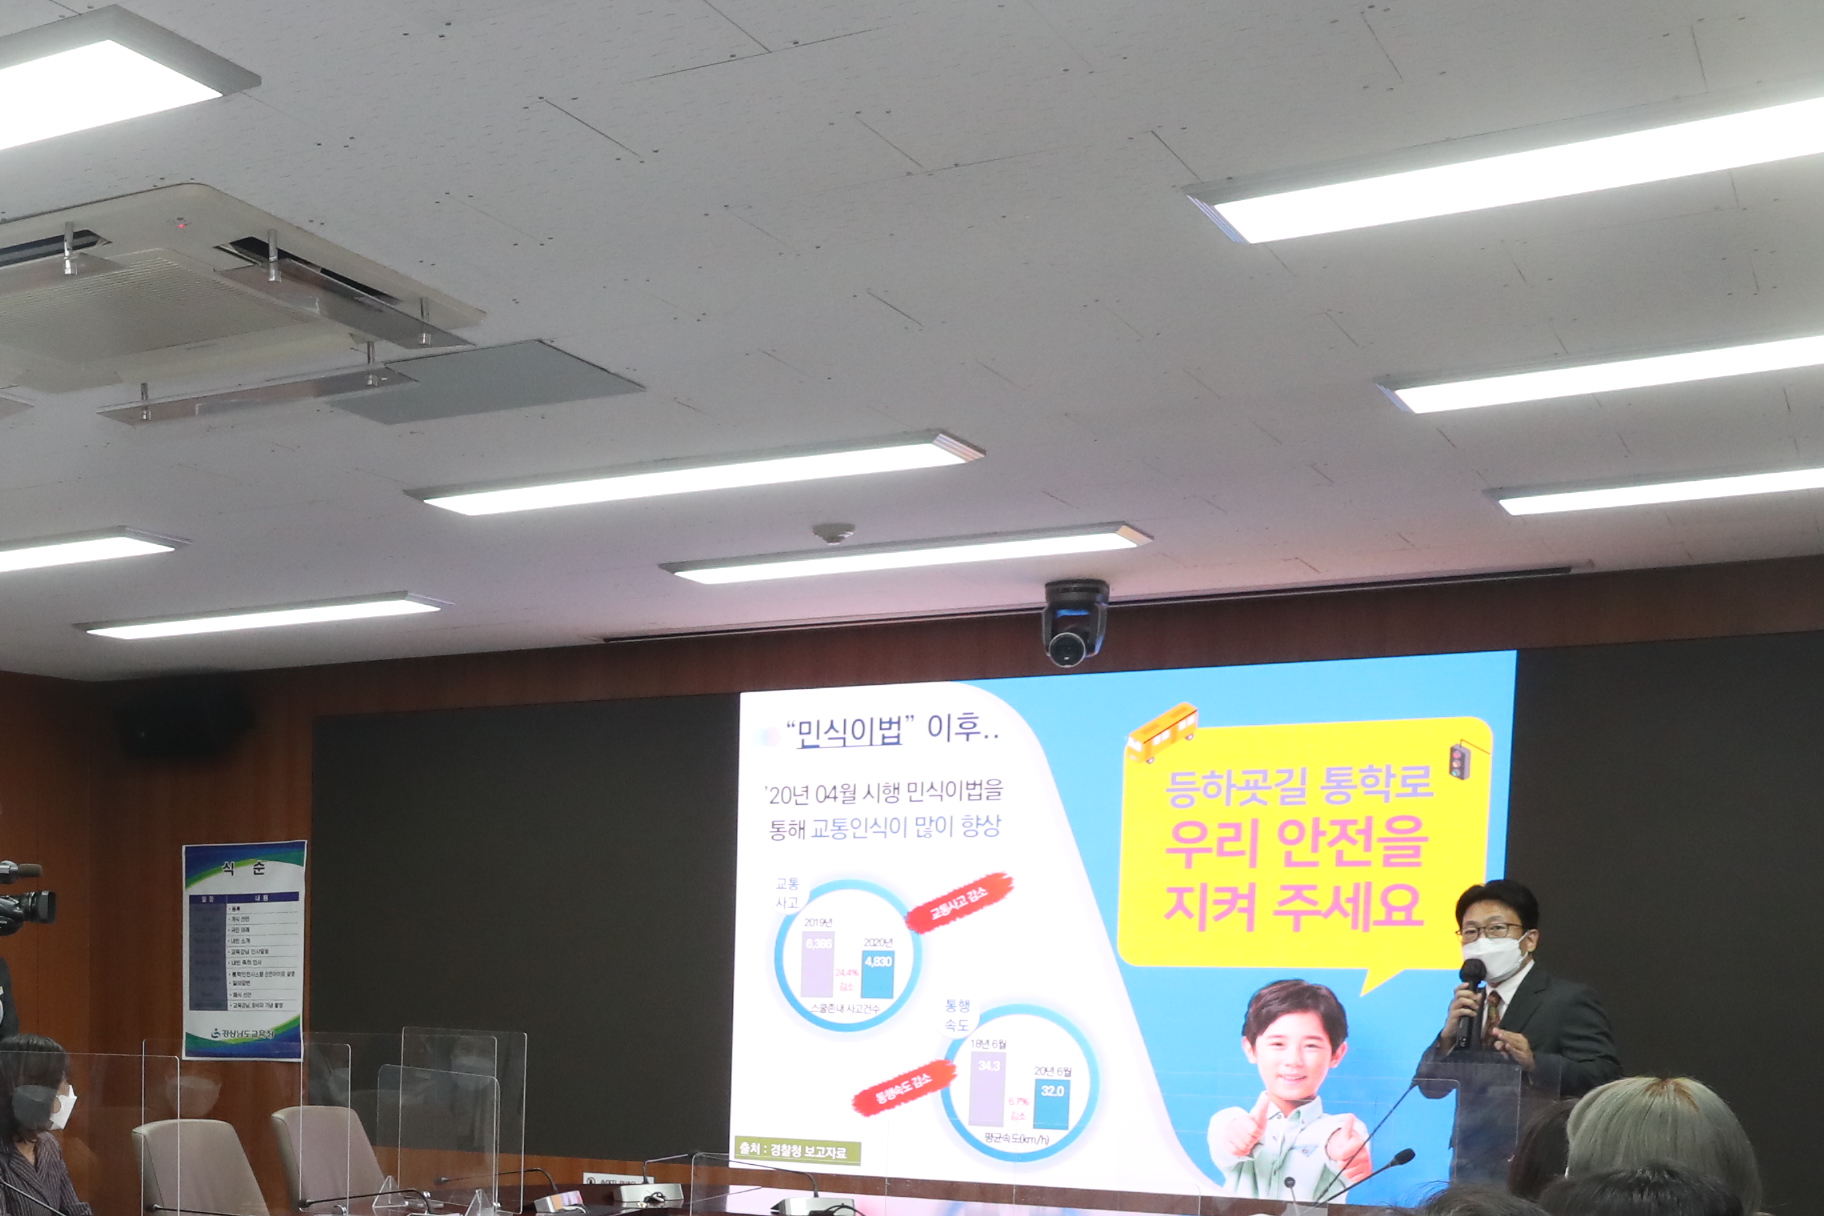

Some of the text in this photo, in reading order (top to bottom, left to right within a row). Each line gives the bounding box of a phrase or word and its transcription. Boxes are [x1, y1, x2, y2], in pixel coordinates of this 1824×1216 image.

[928, 712, 999, 742] 이후..
[815, 783, 857, 805] 04월
[862, 782, 901, 804] 시행
[907, 778, 1004, 802] 민식이법을
[1165, 764, 1434, 809] 등하굣길 통학로
[769, 814, 1002, 841] 통해 교통인식이 많이 향상
[1165, 815, 1429, 869] 우리 안전을
[222, 861, 266, 876] 식 순
[776, 878, 800, 891] 교통
[776, 896, 799, 909] 사고
[930, 886, 988, 921] 교통사고 감소
[1164, 881, 1425, 933] 지켜 주세요
[804, 917, 833, 928] 2019년
[864, 938, 894, 949] 2020년
[864, 956, 892, 968] 4,830
[835, 968, 859, 978] 24.4%
[839, 983, 854, 992] 감소
[811, 1003, 880, 1015] 스쿨존내 사고건수
[945, 999, 970, 1013] 통행
[945, 1019, 969, 1032] 속도
[977, 1060, 1001, 1072] 34.3
[1056, 1067, 1072, 1078] 6월
[875, 1073, 933, 1105] 통행속도 감소
[1041, 1085, 1065, 1097] 32.0
[1010, 1111, 1027, 1121] 감소
[739, 1142, 761, 1155] 출처
[770, 1143, 802, 1158] 경찰청
[804, 1145, 847, 1159] 보고자료
